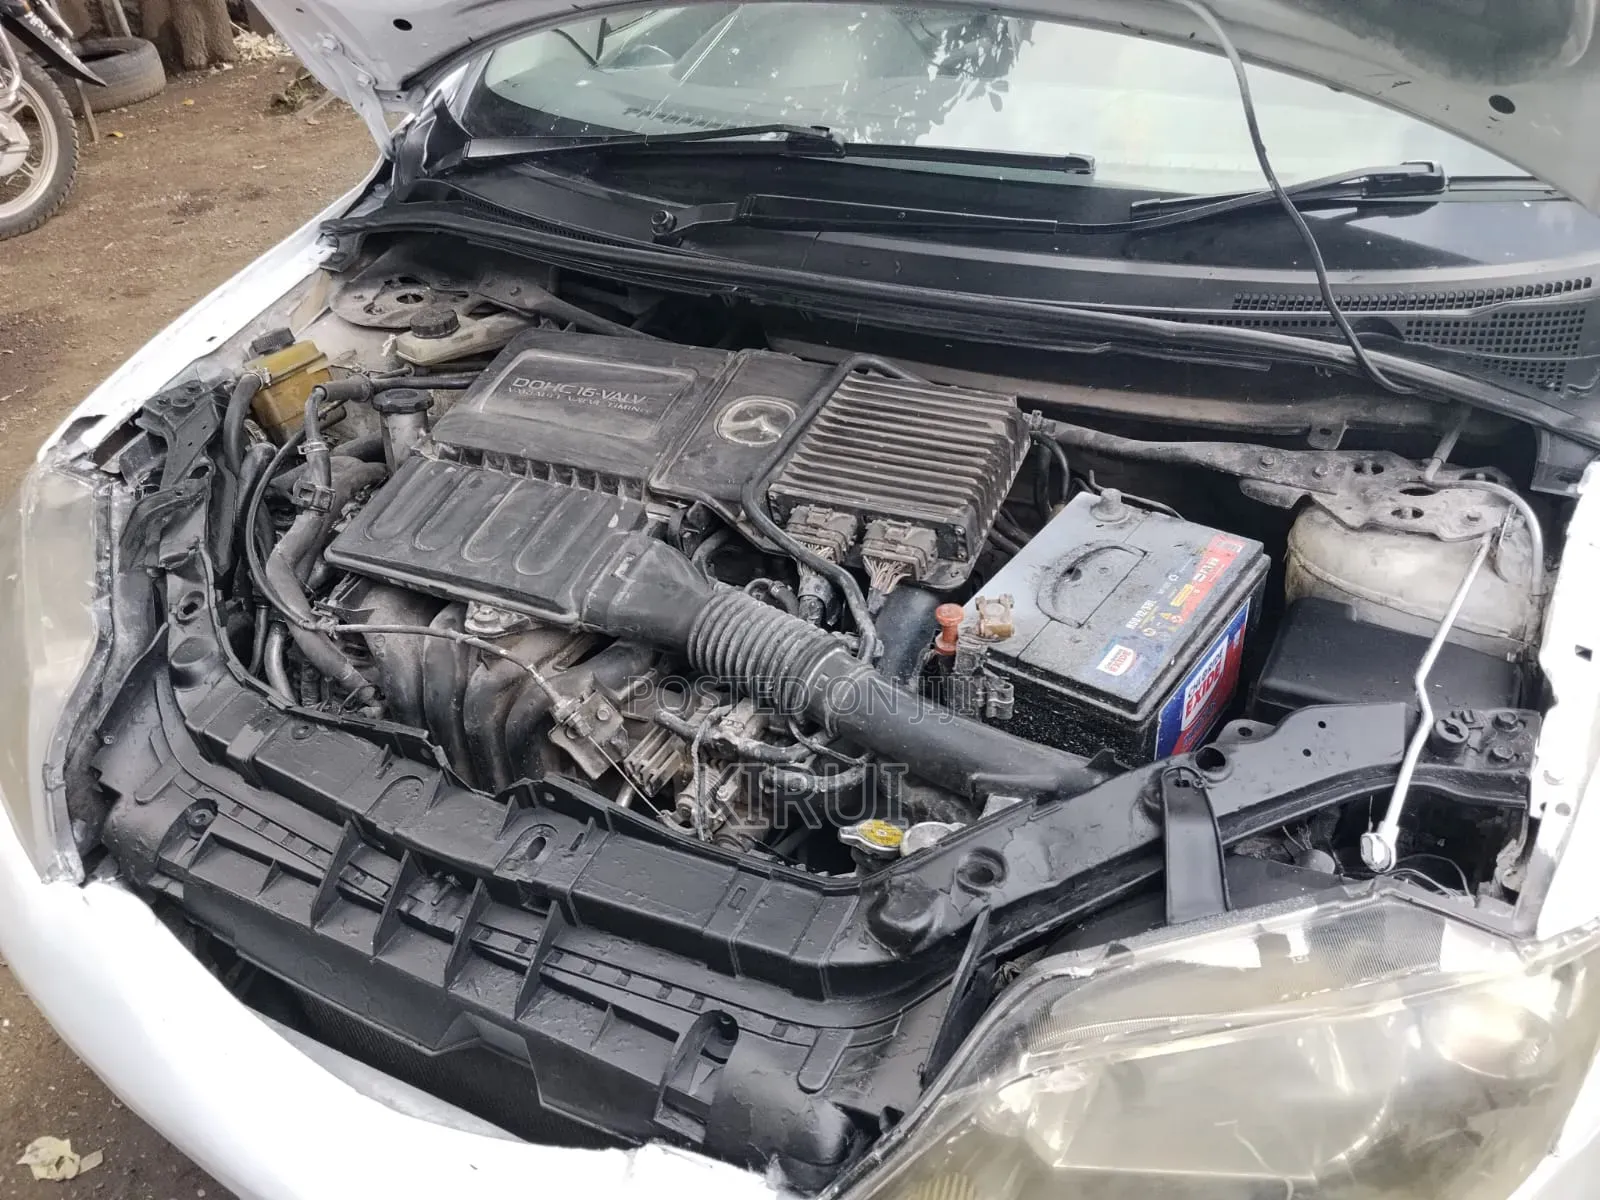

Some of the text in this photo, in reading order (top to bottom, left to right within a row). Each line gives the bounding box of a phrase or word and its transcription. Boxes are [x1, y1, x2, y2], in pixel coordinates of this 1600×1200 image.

[512, 377, 576, 395] DOHC
[577, 386, 657, 405] 16-VALV
[1185, 660, 1222, 719] EXIDE
